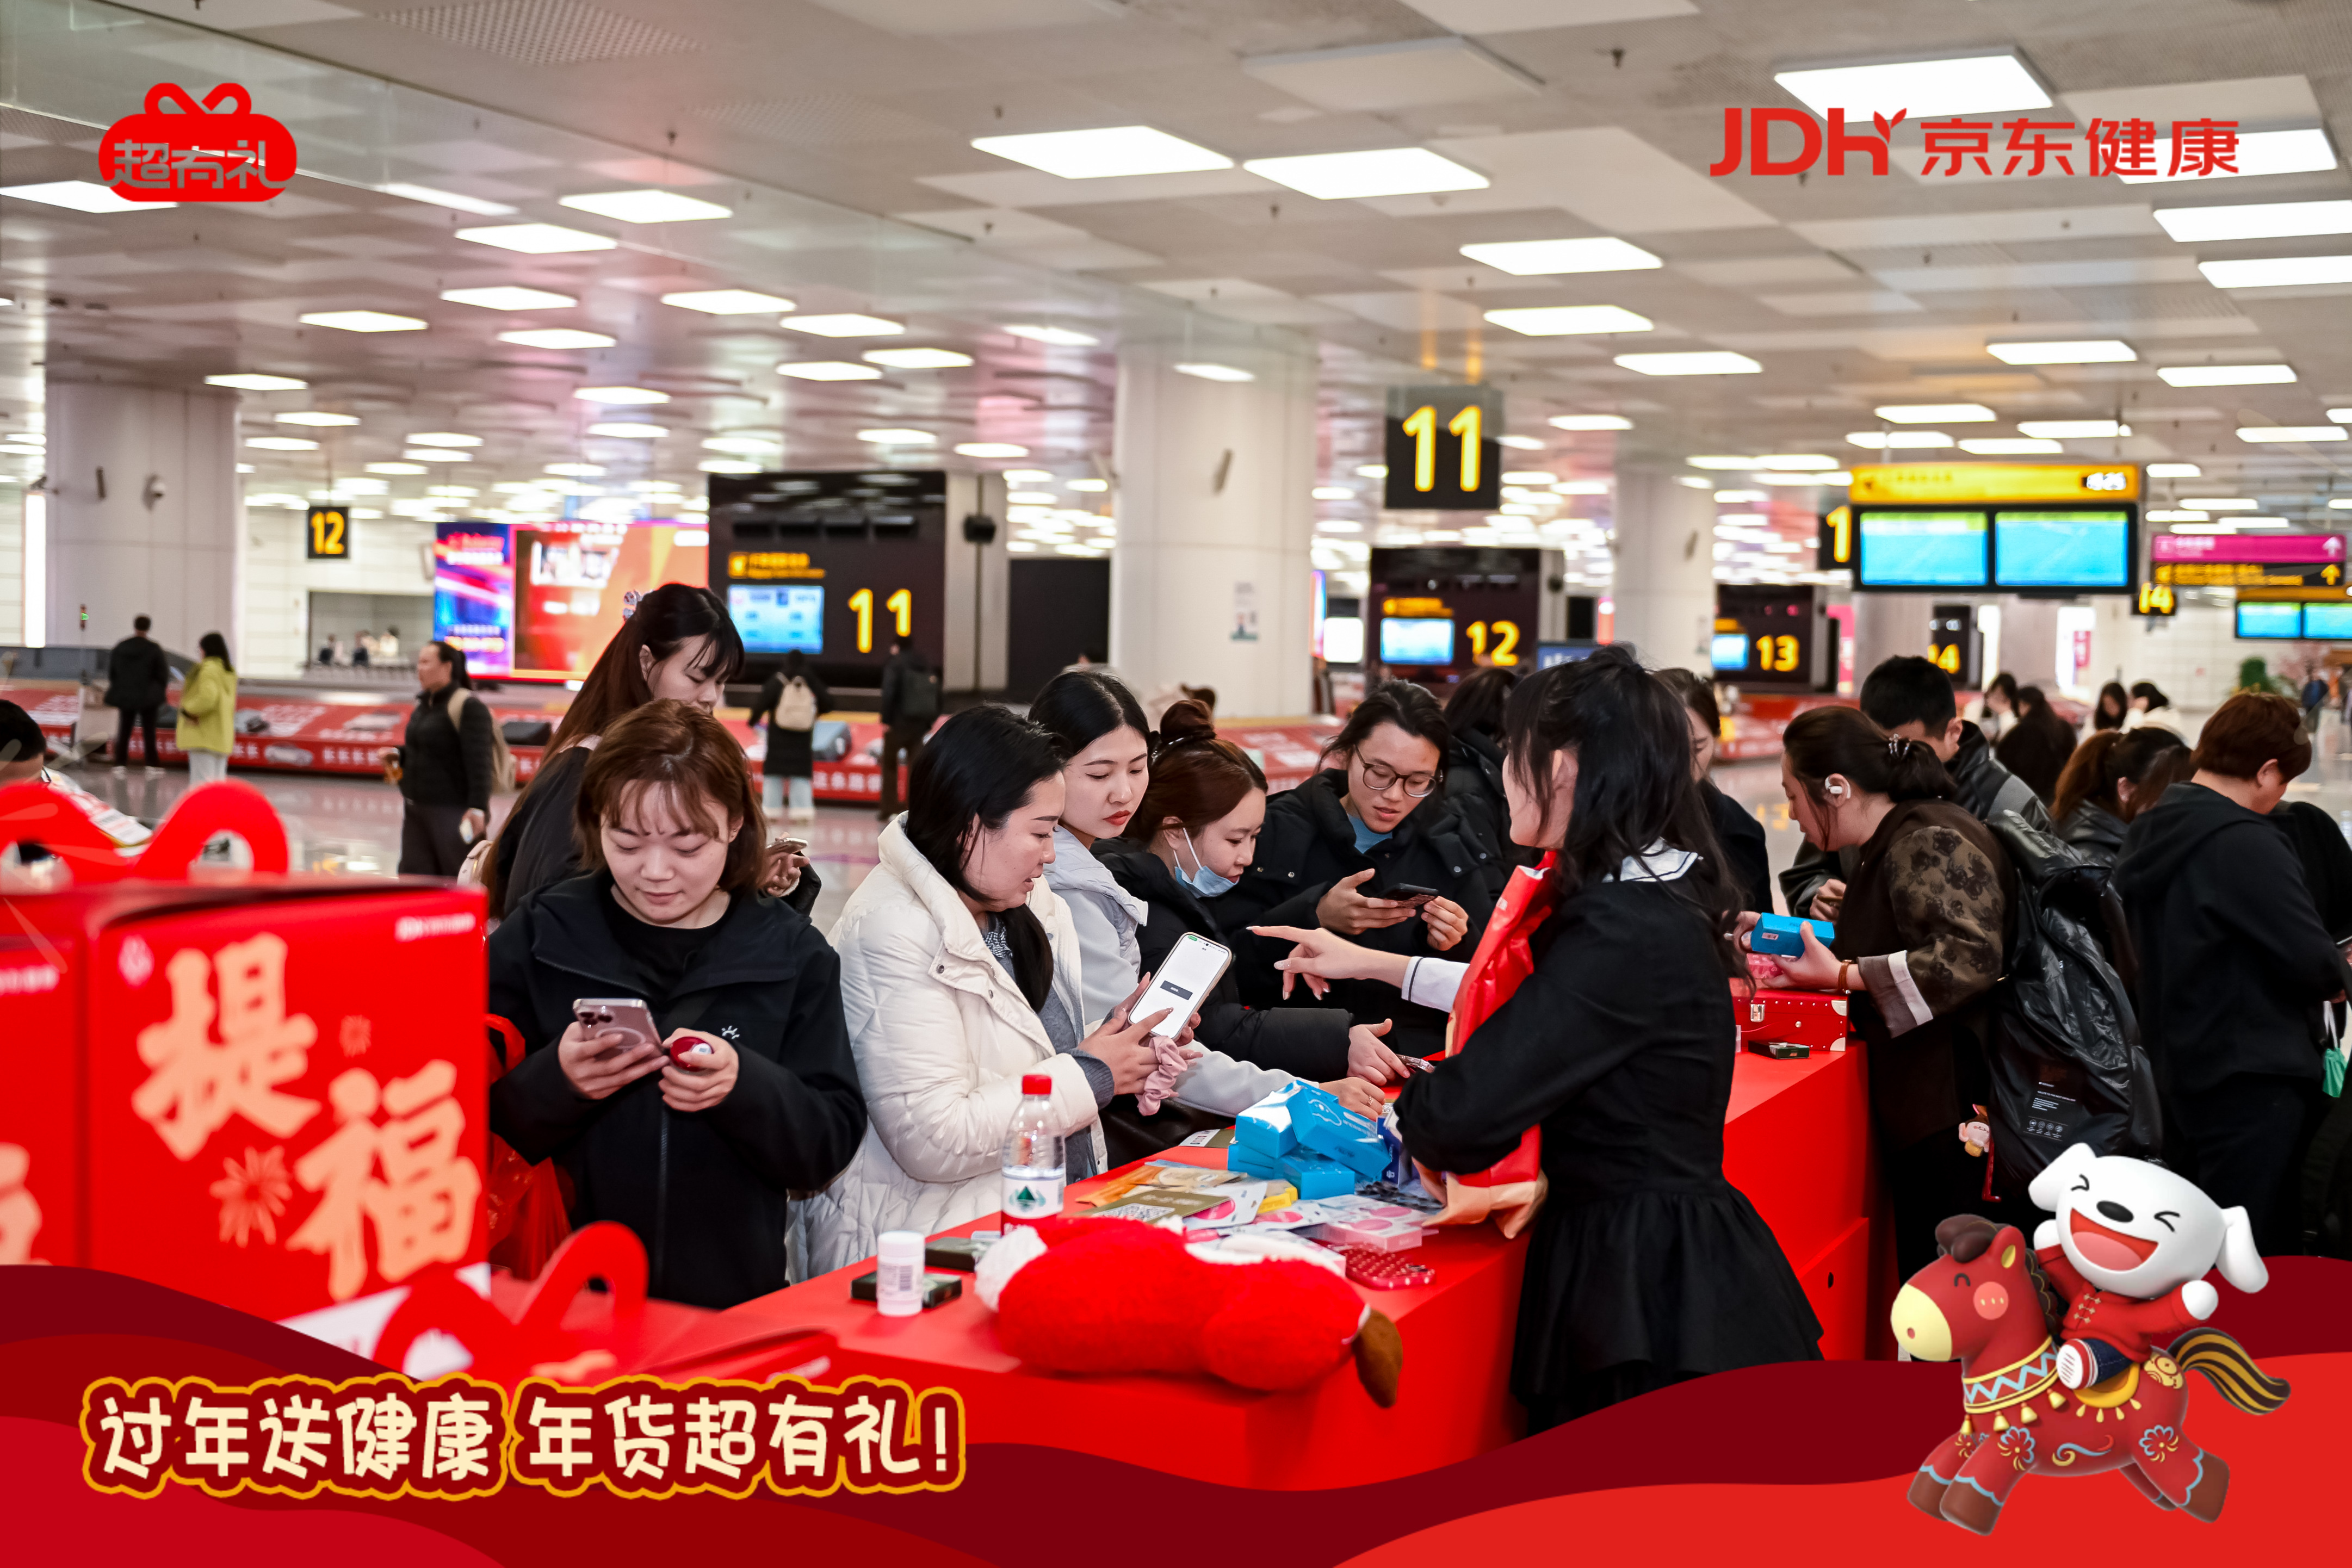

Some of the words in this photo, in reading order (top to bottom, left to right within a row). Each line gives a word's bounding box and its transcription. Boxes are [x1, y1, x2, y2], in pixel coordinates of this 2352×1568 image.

[1402, 405, 1482, 492] 11
[311, 511, 344, 555] 12
[2138, 581, 2174, 613] 14
[848, 588, 912, 653] 11
[1466, 621, 1520, 667] 12
[1756, 635, 1799, 671] 13
[1927, 644, 1960, 674] 14
